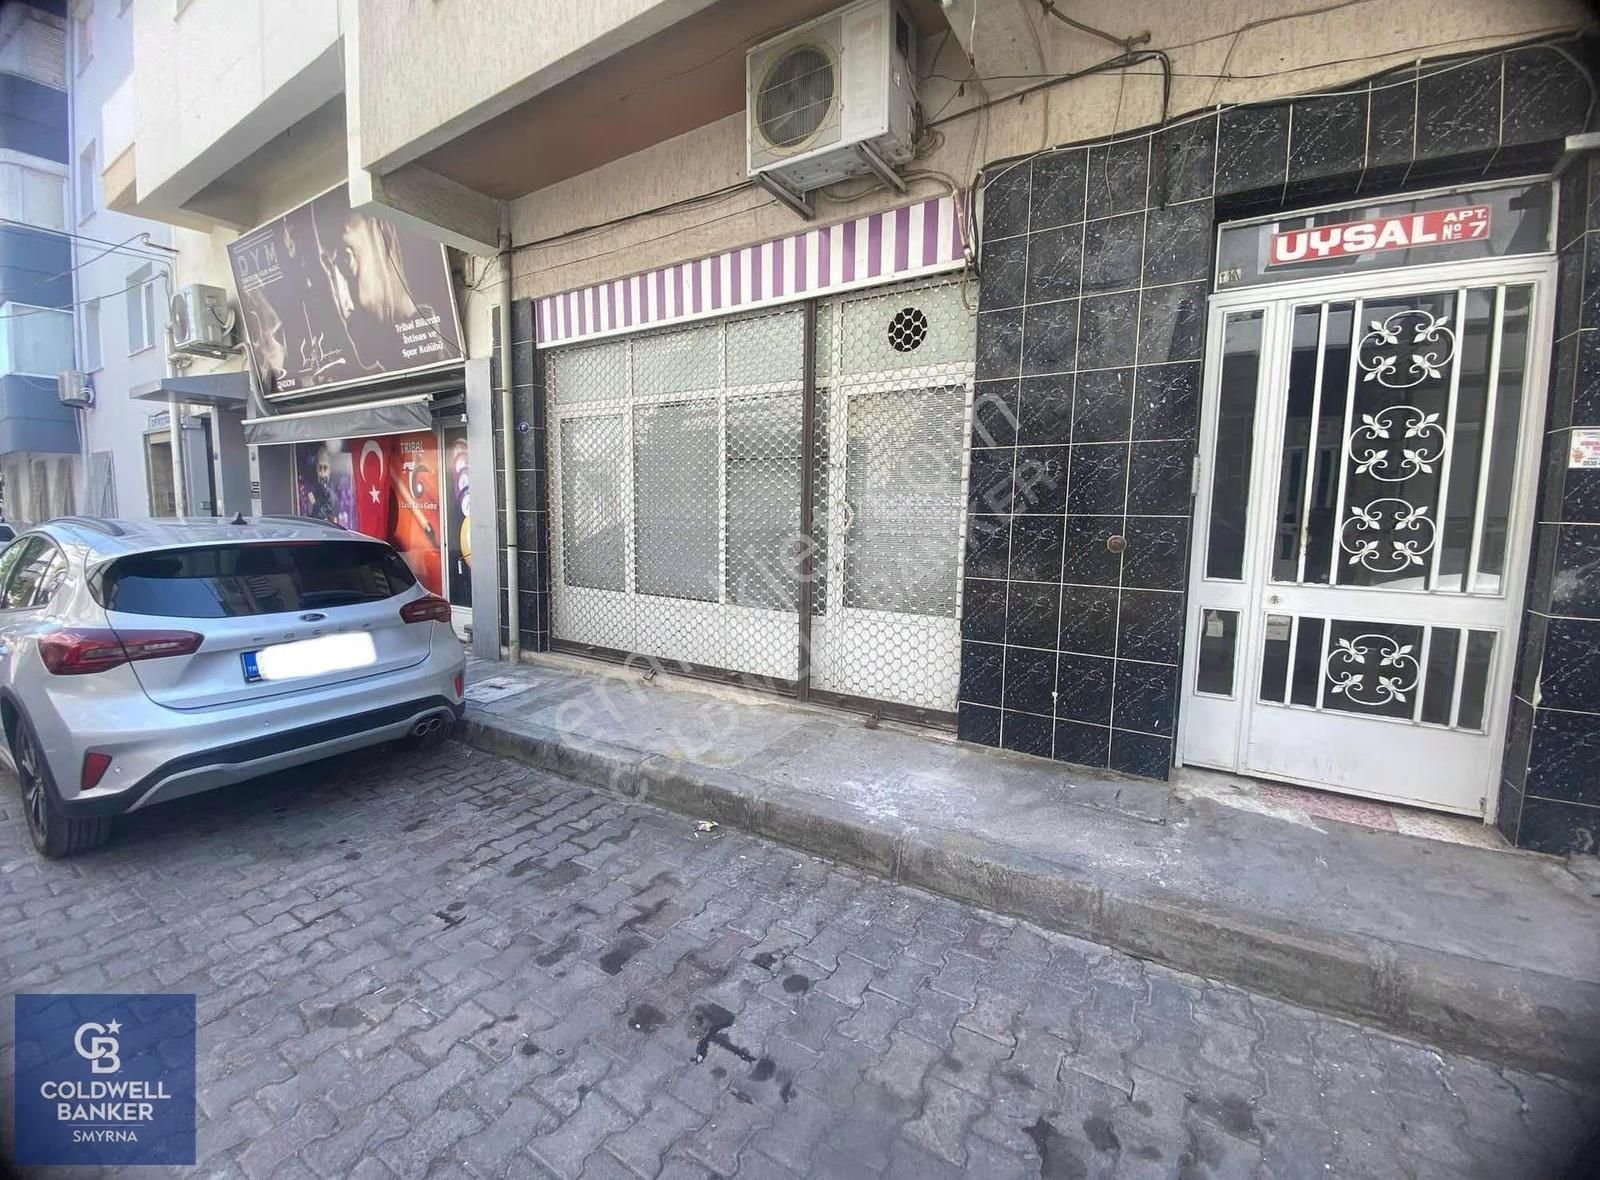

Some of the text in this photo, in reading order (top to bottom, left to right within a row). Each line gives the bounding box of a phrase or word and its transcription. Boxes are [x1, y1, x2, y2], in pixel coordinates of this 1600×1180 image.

[1443, 209, 1487, 222] APT.
[1468, 221, 1487, 237] 7
[1276, 215, 1438, 261] UYSAL
